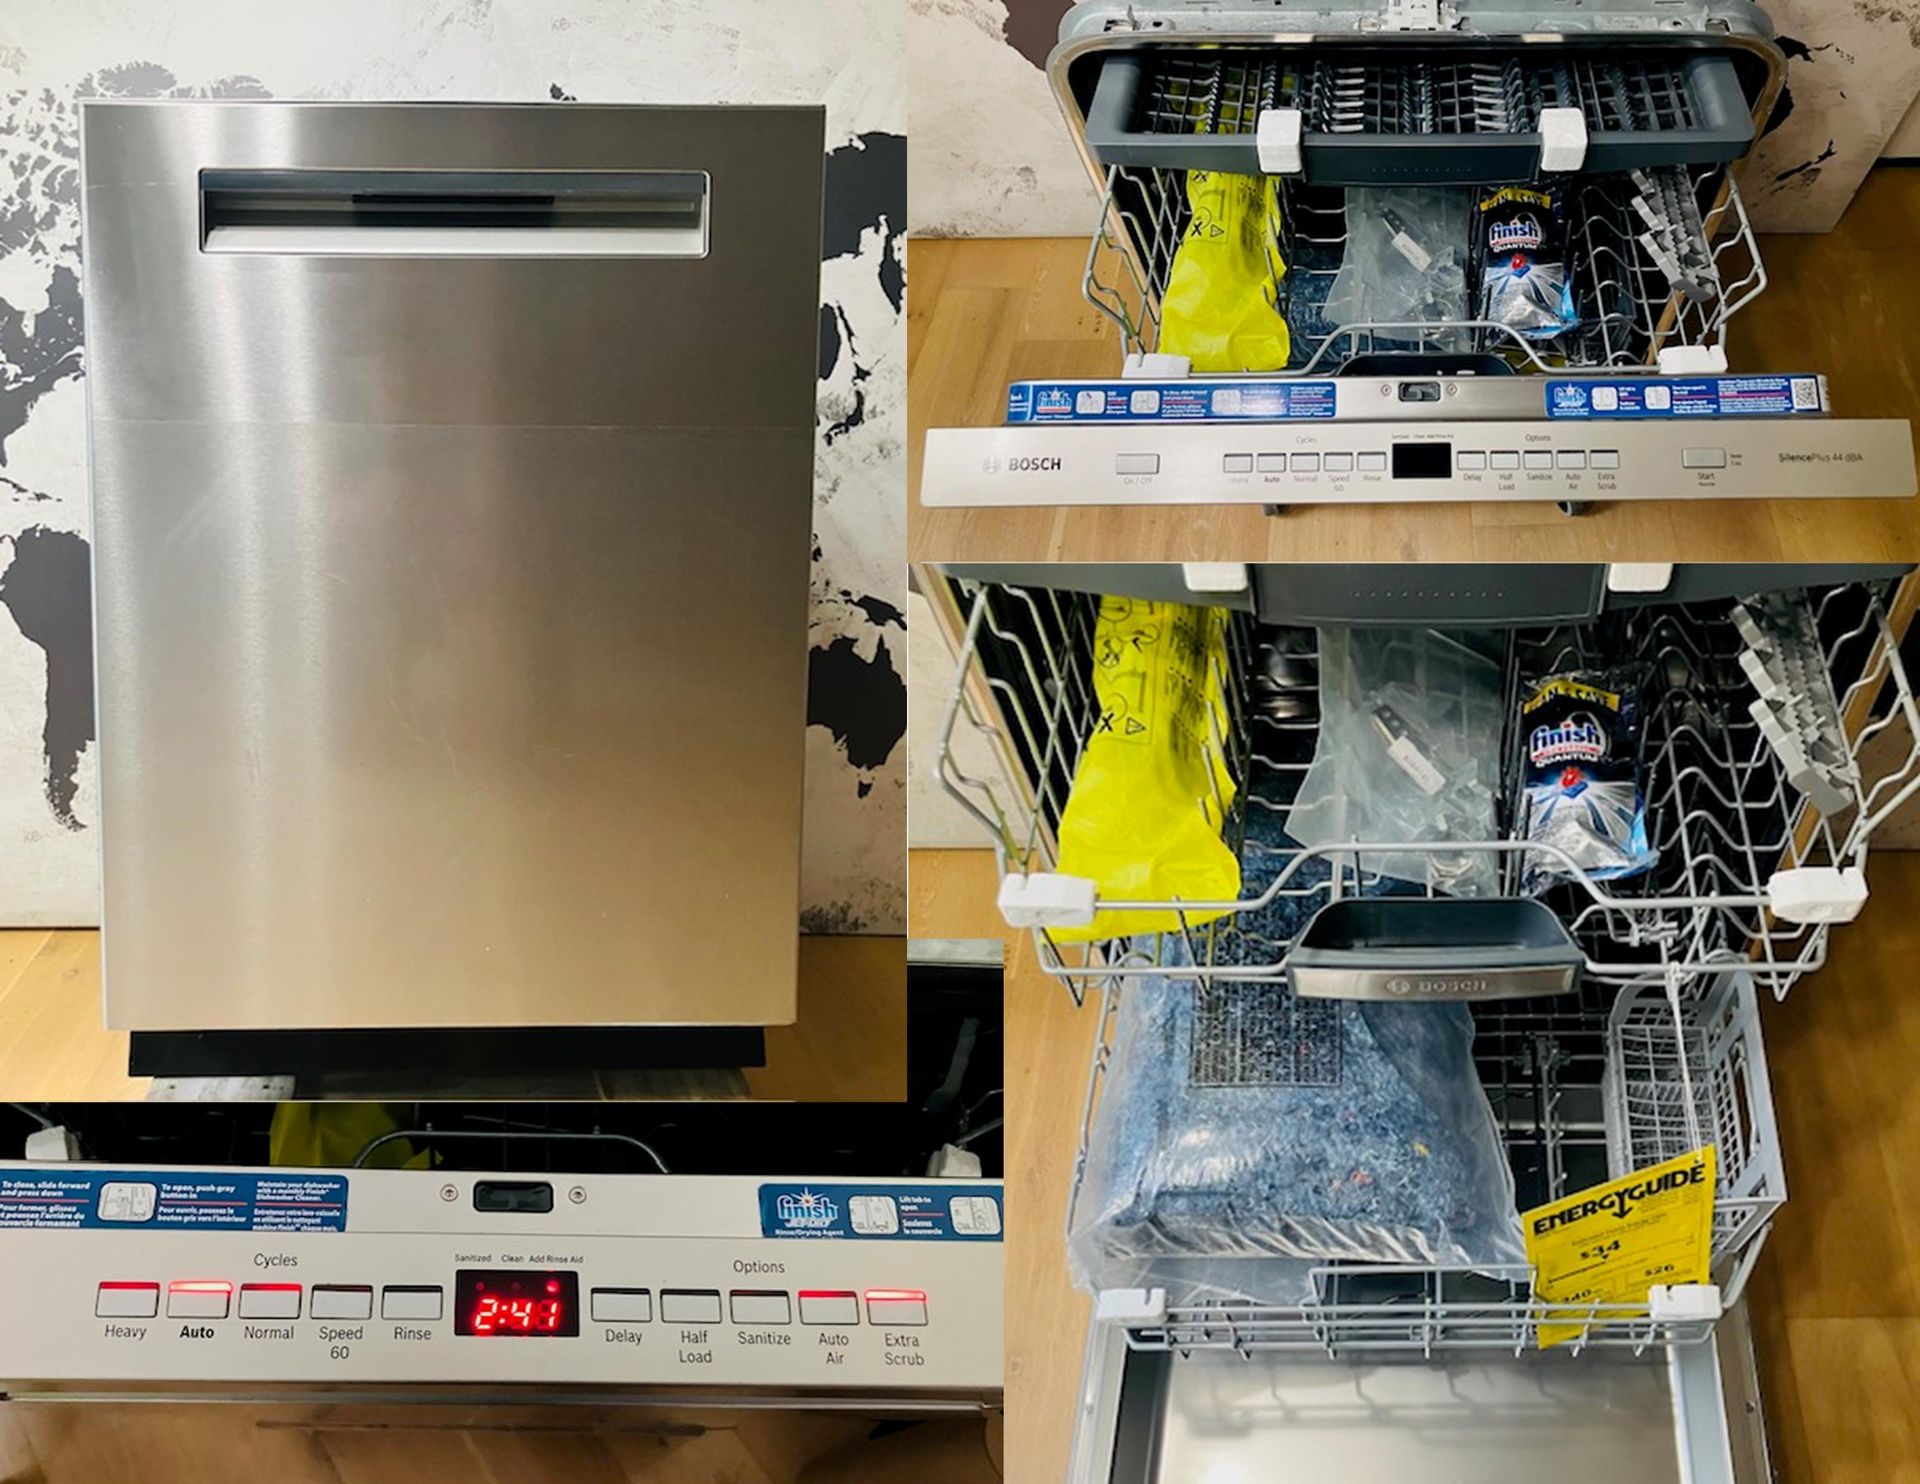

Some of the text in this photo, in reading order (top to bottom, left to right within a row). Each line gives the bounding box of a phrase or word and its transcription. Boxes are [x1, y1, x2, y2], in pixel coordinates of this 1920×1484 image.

[1490, 219, 1539, 240] finish
[1525, 433, 1552, 443] Options
[1008, 457, 1062, 472] BOSCH
[1778, 453, 1830, 463] SilencePlus
[1832, 453, 1843, 462] 44
[1264, 475, 1280, 483] Auto
[1463, 473, 1482, 483] Delay
[1564, 473, 1581, 481] Auto
[1498, 482, 1515, 491] Load
[1532, 721, 1601, 750] finish
[1535, 752, 1599, 768] QUANTUM
[2, 1181, 14, 1189] To
[58, 1182, 91, 1190] forward
[0, 1189, 16, 1197] and
[41, 1189, 64, 1197] down
[1533, 1163, 1706, 1237] ENERGYGUIDE
[776, 1193, 840, 1220] finish
[254, 1253, 298, 1268] Cycles
[455, 1253, 584, 1264] Sanitized Clean Add Rinse Aid
[733, 1260, 785, 1274] Options
[474, 1297, 558, 1330] 2:41
[105, 1325, 147, 1341] Heavy
[180, 1326, 215, 1339] Auto
[244, 1326, 295, 1340] Normal
[319, 1326, 364, 1341] Speed
[394, 1327, 432, 1340] Rinse
[605, 1329, 643, 1345] Delay
[681, 1330, 708, 1344] Half
[738, 1331, 792, 1345] Sanitize
[818, 1333, 849, 1346] Auto
[884, 1333, 920, 1347] Extra
[330, 1346, 350, 1360] 60
[679, 1350, 712, 1363] Load
[826, 1352, 845, 1364] Air
[884, 1352, 925, 1366] Scrub
